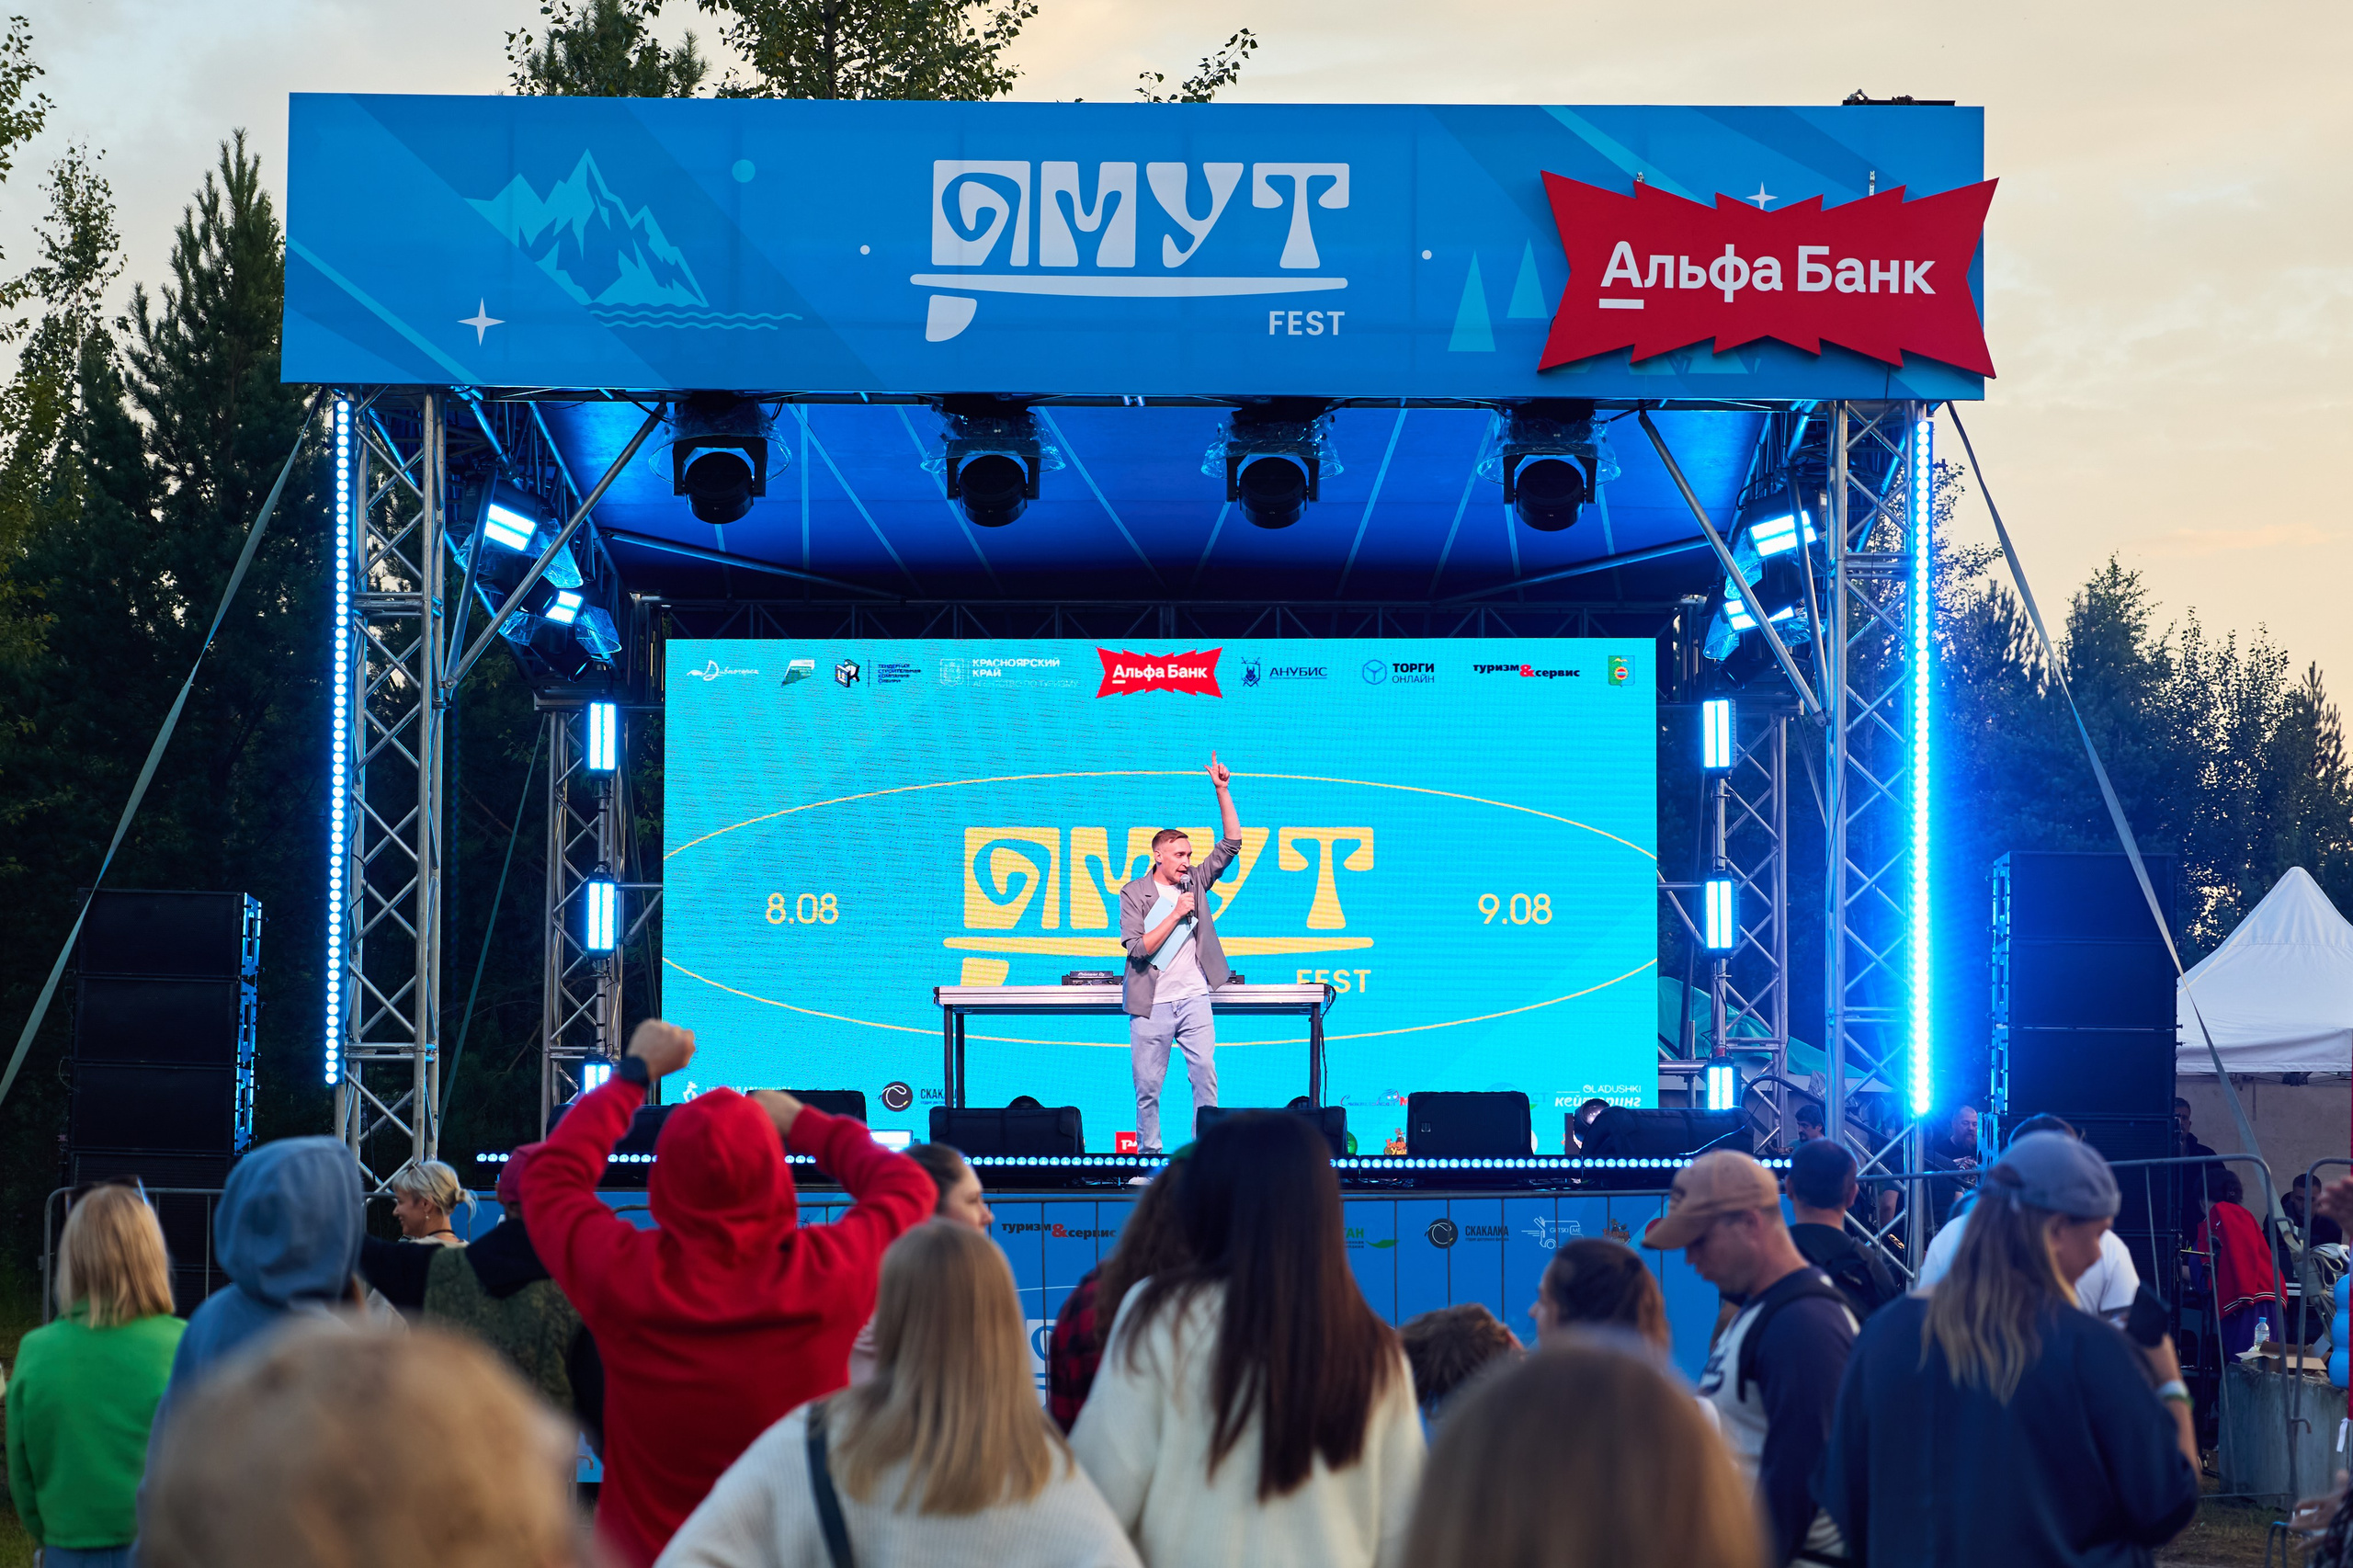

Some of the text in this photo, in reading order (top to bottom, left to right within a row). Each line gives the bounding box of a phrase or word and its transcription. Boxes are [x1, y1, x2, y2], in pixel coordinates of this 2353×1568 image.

[1599, 240, 1937, 304] Альфа Банк
[1268, 311, 1346, 335] FEST
[972, 657, 1061, 667] КРАСНОЯРСКИЙ
[1392, 663, 1435, 673] ТОРГИ
[972, 667, 1002, 677] КРАЙ
[1112, 664, 1208, 682] Альфа Банк
[1269, 667, 1328, 676] АНУБИС
[1473, 664, 1580, 679] туризм&сервис
[1392, 674, 1435, 683] ОНЛАЙН
[766, 892, 839, 925] 8.08
[1478, 892, 1553, 926] 9.08
[1297, 969, 1371, 994] FEST
[1583, 1085, 1642, 1094] OLADUSHKI
[1554, 1095, 1642, 1108] кейринг
[1465, 1225, 1509, 1236] СКАКАЛКА
